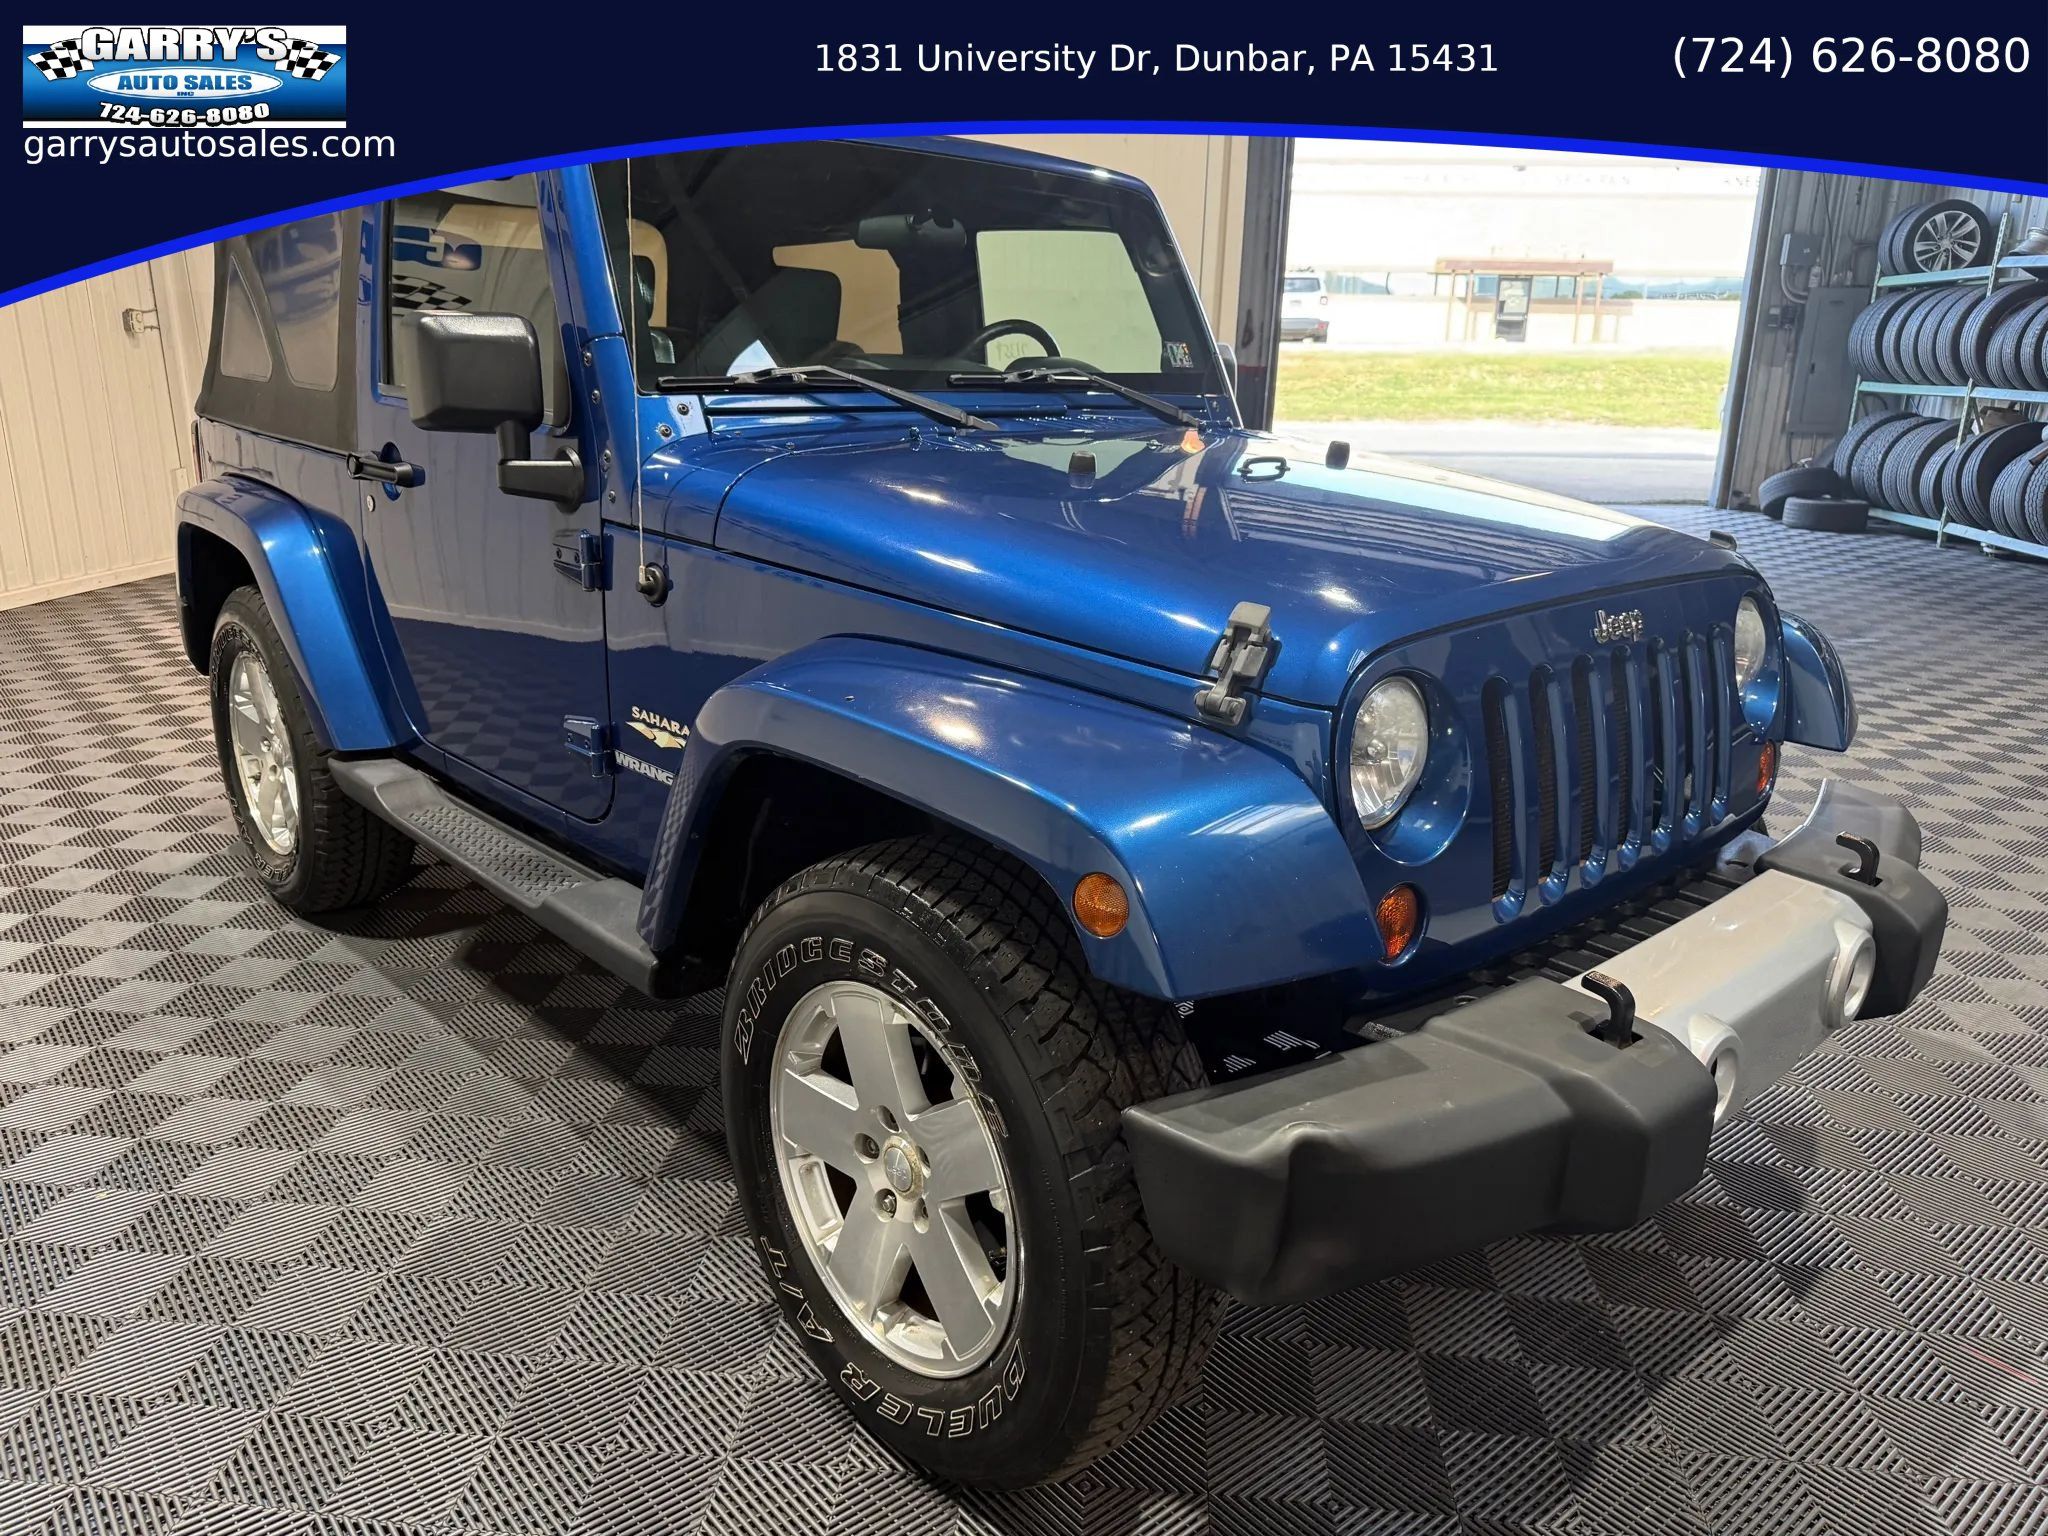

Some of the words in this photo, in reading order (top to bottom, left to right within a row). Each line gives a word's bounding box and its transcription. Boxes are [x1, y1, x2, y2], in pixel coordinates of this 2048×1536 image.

[1593, 609, 1643, 644] Jeep
[631, 705, 691, 737] SAHARA
[614, 749, 676, 786] WRANG
[733, 935, 1010, 1138] BRIDGESTONE
[839, 1338, 1027, 1439] DUELER
